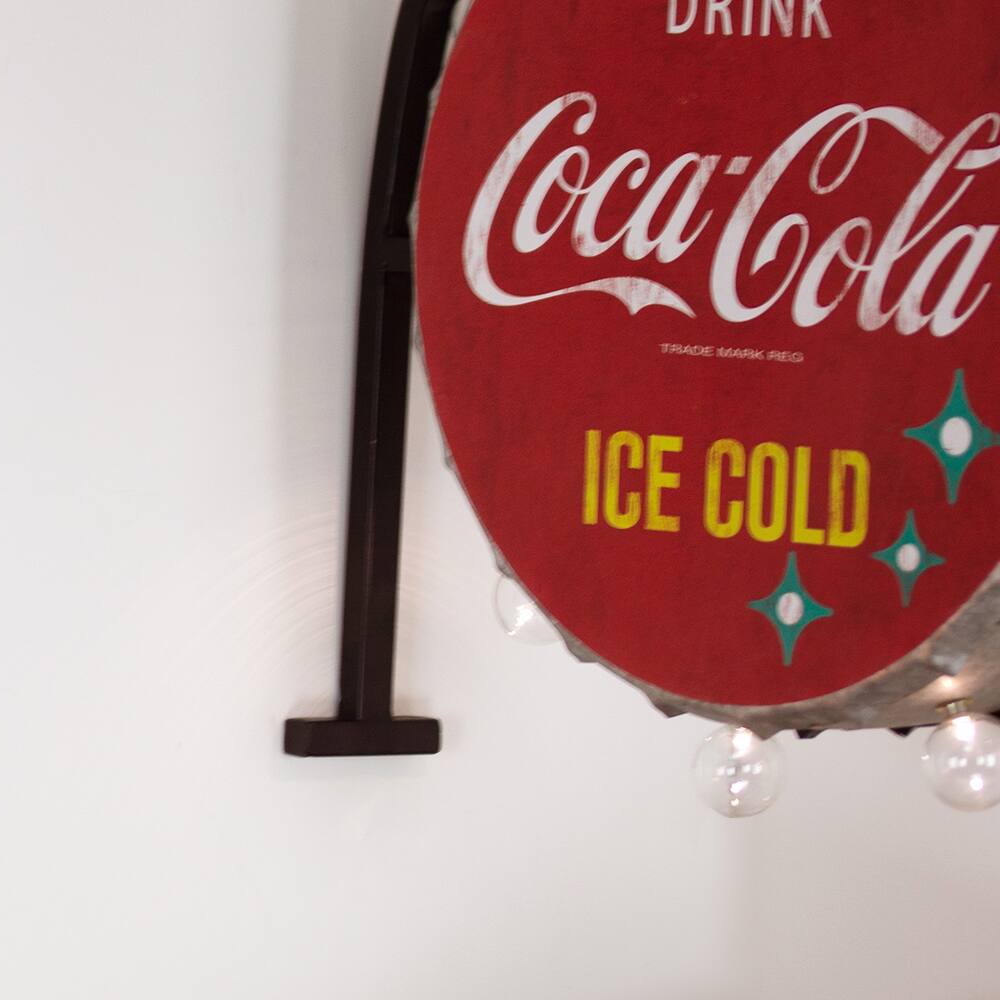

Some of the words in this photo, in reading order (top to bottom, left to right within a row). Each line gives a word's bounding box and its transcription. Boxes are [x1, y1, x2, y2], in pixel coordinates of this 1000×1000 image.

[462, 90, 1000, 338] Coca-Cola
[659, 342, 714, 357] TRADE
[715, 346, 765, 360] MARK
[581, 428, 684, 533] ICE
[703, 437, 871, 548] COLD
